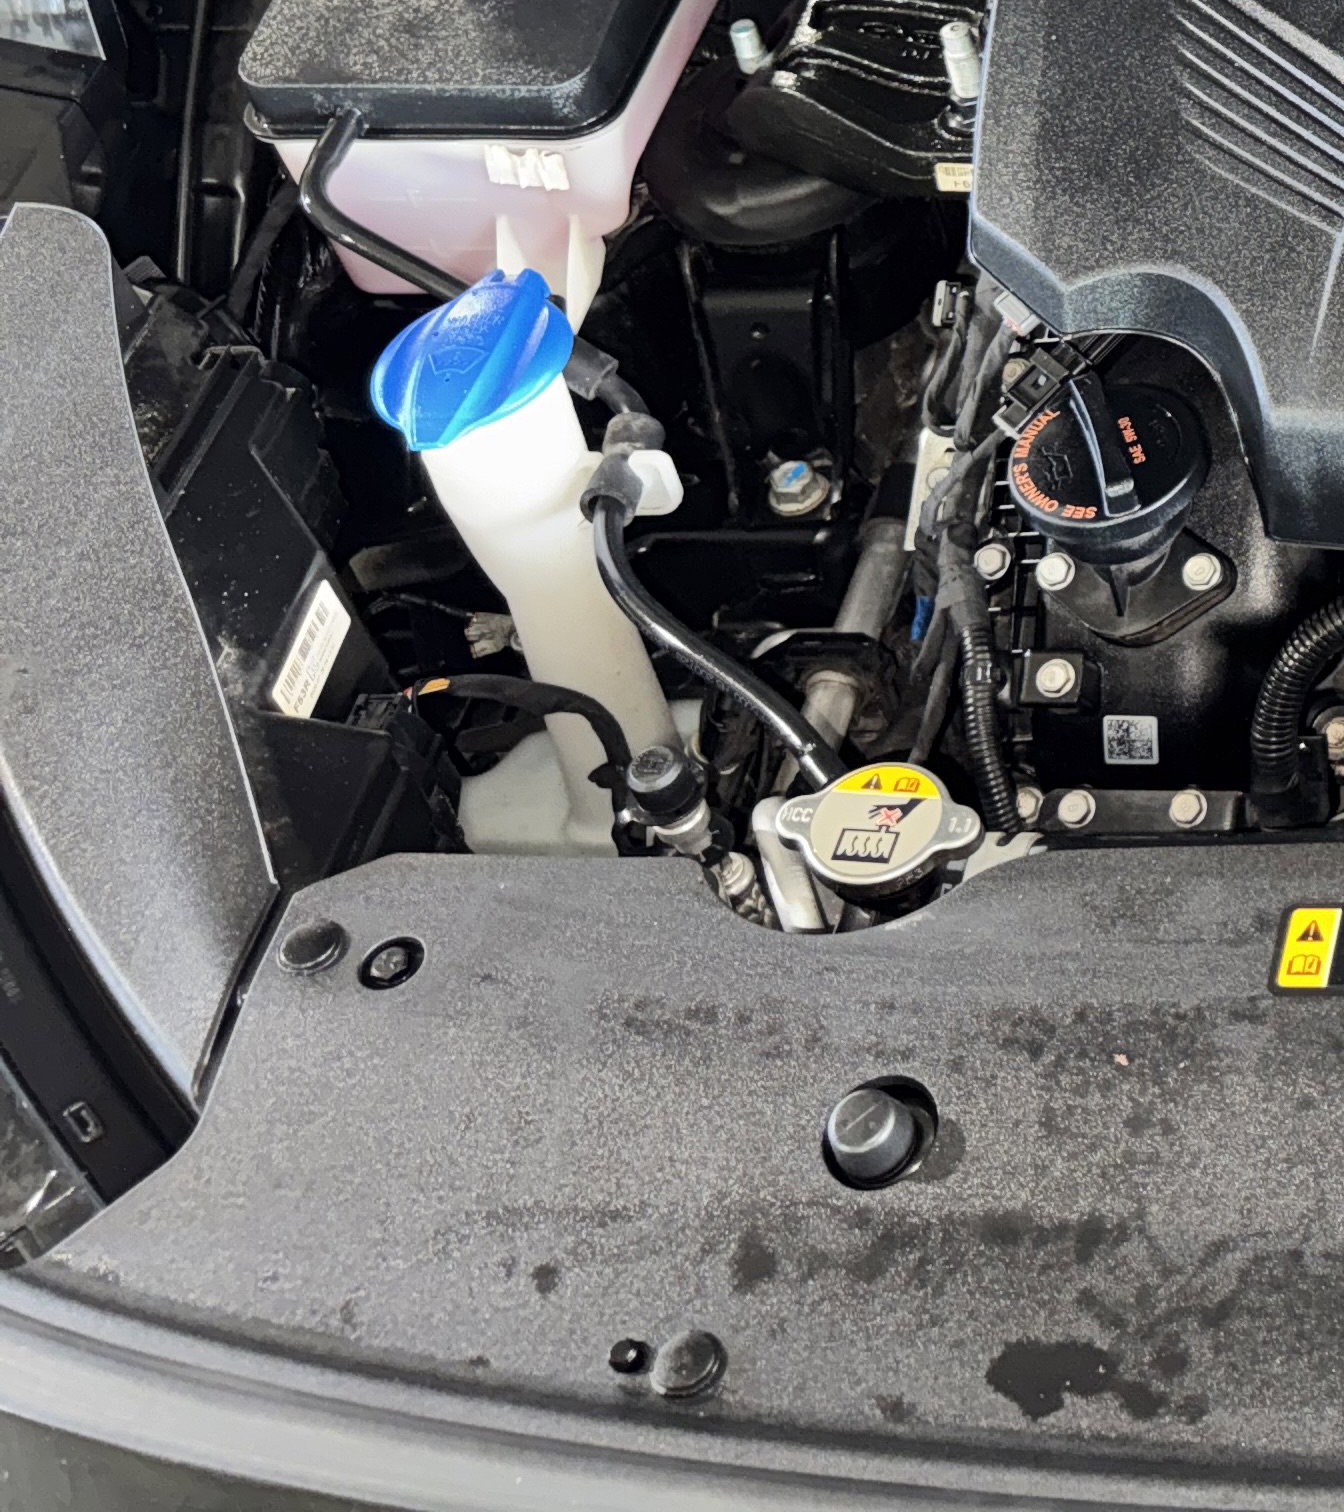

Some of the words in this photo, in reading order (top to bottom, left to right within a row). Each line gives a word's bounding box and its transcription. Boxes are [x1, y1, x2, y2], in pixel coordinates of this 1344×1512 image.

[1014, 409, 1061, 458] MANUAL
[1128, 443, 1146, 465] SAE
[1061, 504, 1098, 519] SEE
